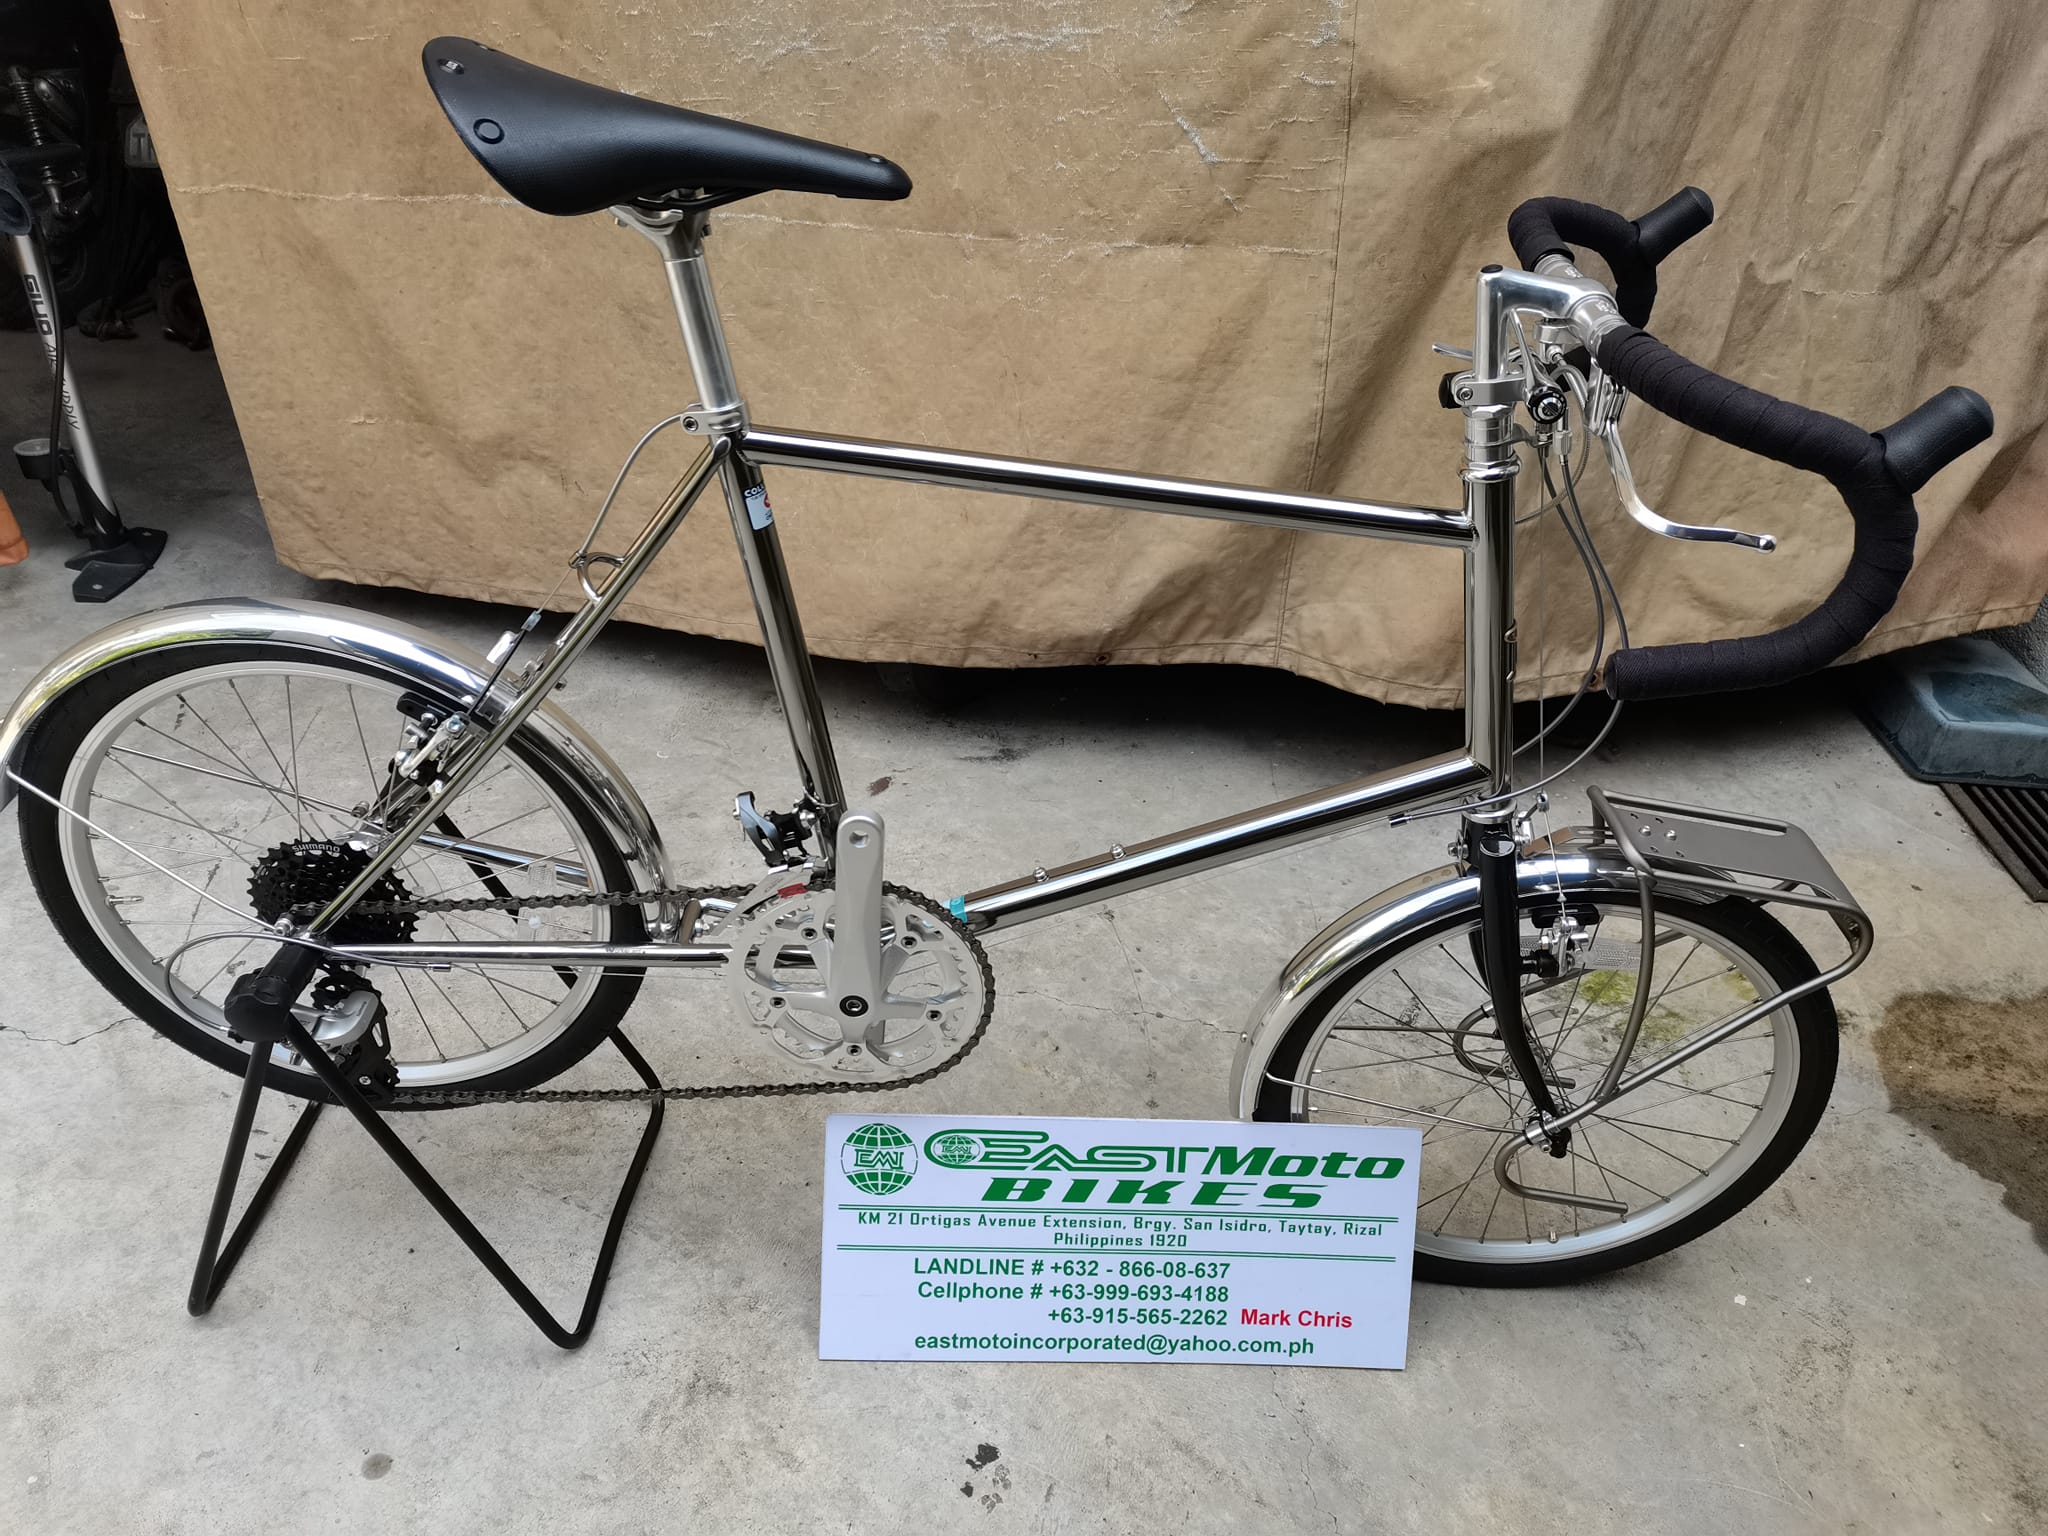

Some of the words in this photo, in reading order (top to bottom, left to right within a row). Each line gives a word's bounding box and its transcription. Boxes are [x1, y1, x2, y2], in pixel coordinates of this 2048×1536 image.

[292, 843, 341, 853] SHIMANO
[981, 1176, 1329, 1209] BIKES
[858, 1211, 881, 1226] KM
[887, 1212, 903, 1226] 21
[910, 1212, 971, 1229] Ortigas
[977, 1214, 1037, 1228] Avenue
[1043, 1214, 1128, 1230] Extension,
[1133, 1216, 1177, 1233] Brgy.
[1183, 1217, 1213, 1232] San
[1219, 1218, 1273, 1234] Isidro,
[1278, 1219, 1338, 1237] Taytay,
[1343, 1222, 1383, 1237] Rizal
[1053, 1232, 1143, 1249] Philippines
[1150, 1233, 1188, 1248] 1920
[914, 1257, 1025, 1276] LANDLINE
[1031, 1259, 1045, 1276] #
[1050, 1259, 1100, 1277] +632
[1118, 1260, 1231, 1279] 866-08-637
[917, 1281, 1024, 1303] Cellphone
[1030, 1282, 1044, 1300] #
[1049, 1283, 1229, 1303] +63-999-693-4188
[1047, 1306, 1228, 1326] +63-915-565-2262
[1241, 1308, 1291, 1326] Mark
[1298, 1310, 1353, 1329] Chris
[914, 1332, 1315, 1358] eastmotoincorporated@yahoo.com.ph
